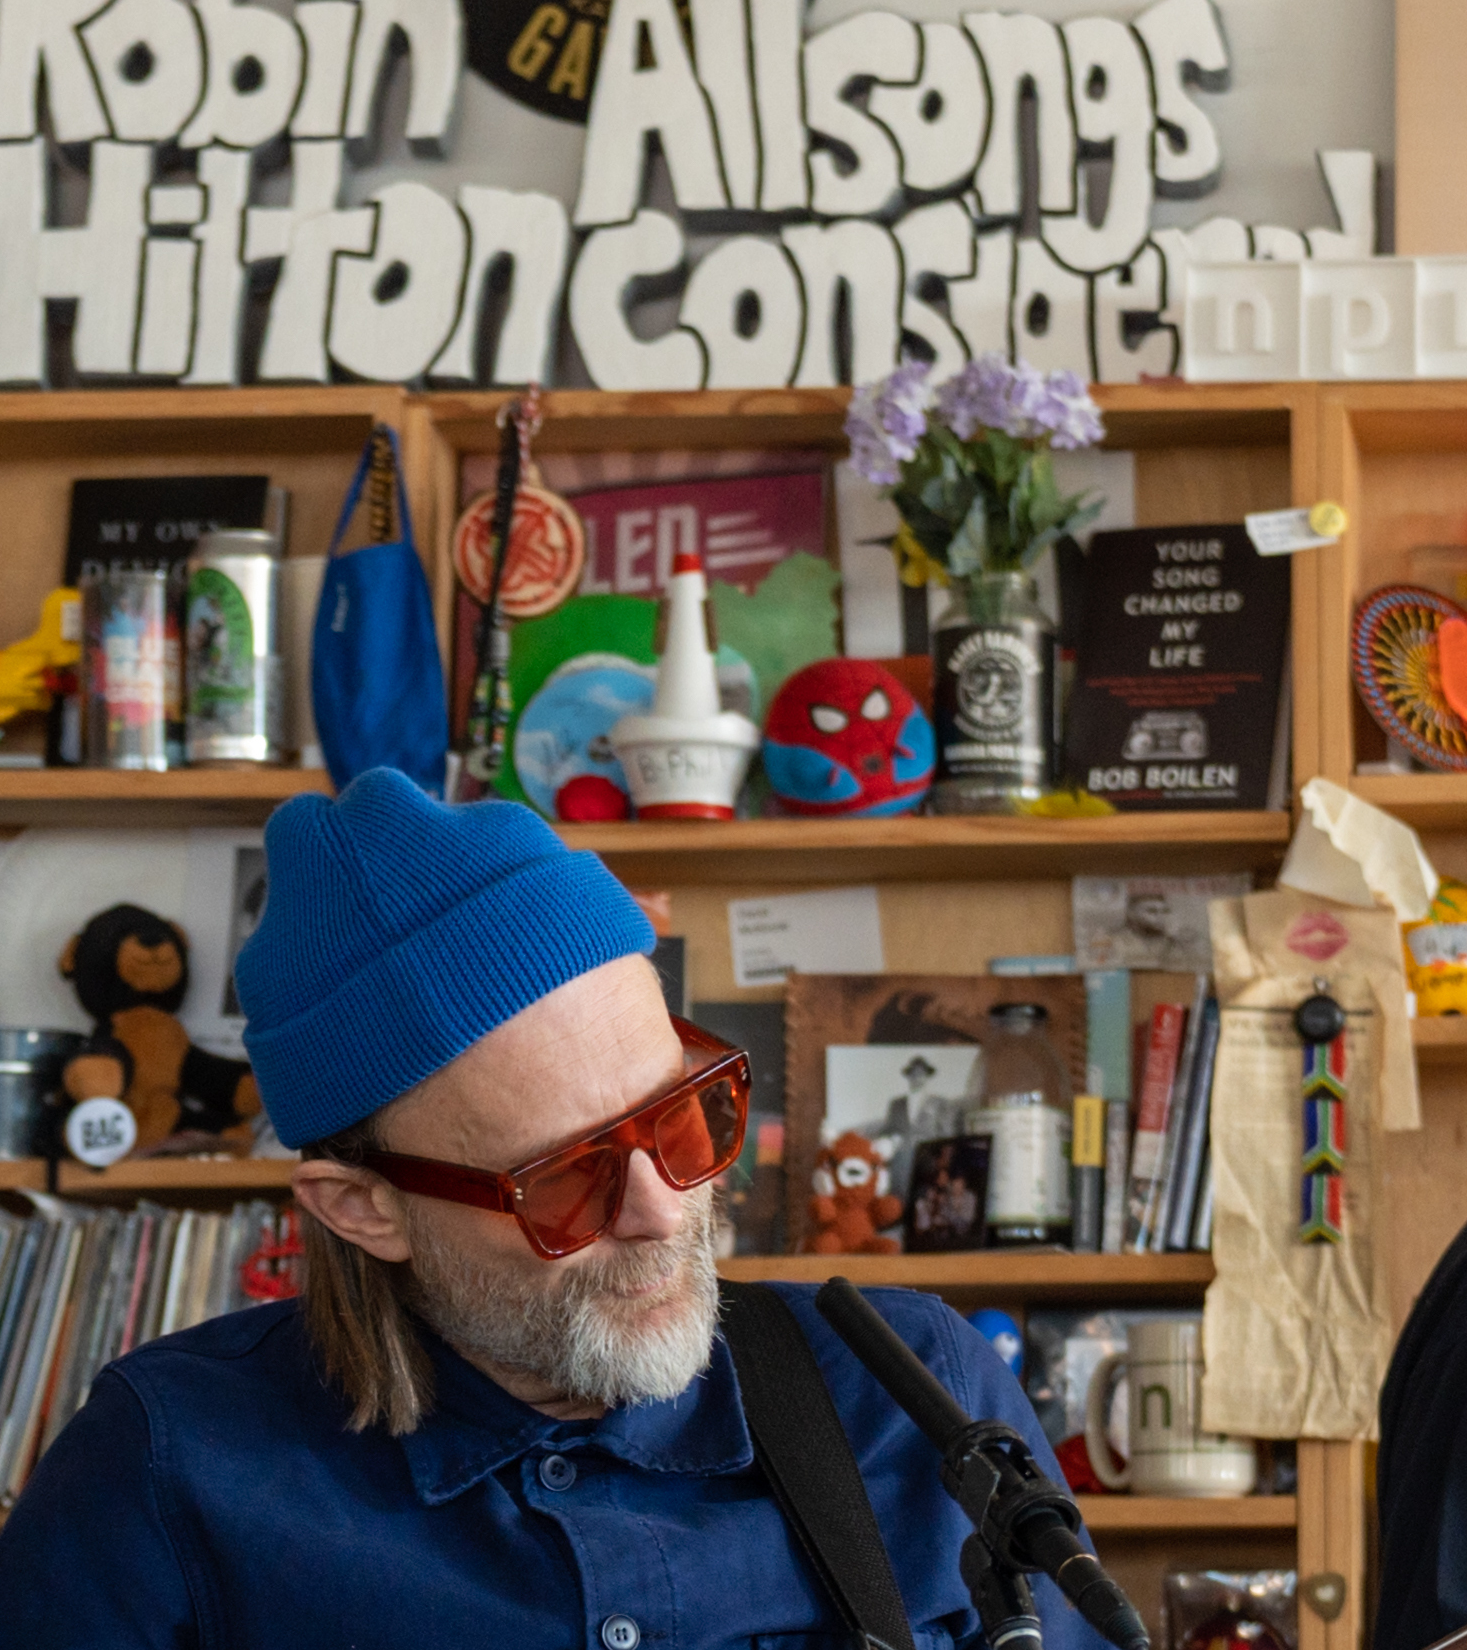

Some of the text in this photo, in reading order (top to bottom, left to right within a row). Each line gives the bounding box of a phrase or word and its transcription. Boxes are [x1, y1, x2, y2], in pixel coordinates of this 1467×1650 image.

[99, 520, 135, 544] MY
[1155, 539, 1224, 560] YOUR
[1152, 567, 1220, 588] SONG
[1123, 593, 1242, 616] CHANGED
[1161, 622, 1198, 641] MY
[1149, 646, 1204, 668] LIFE
[1088, 765, 1237, 791] BOB BOILEN
